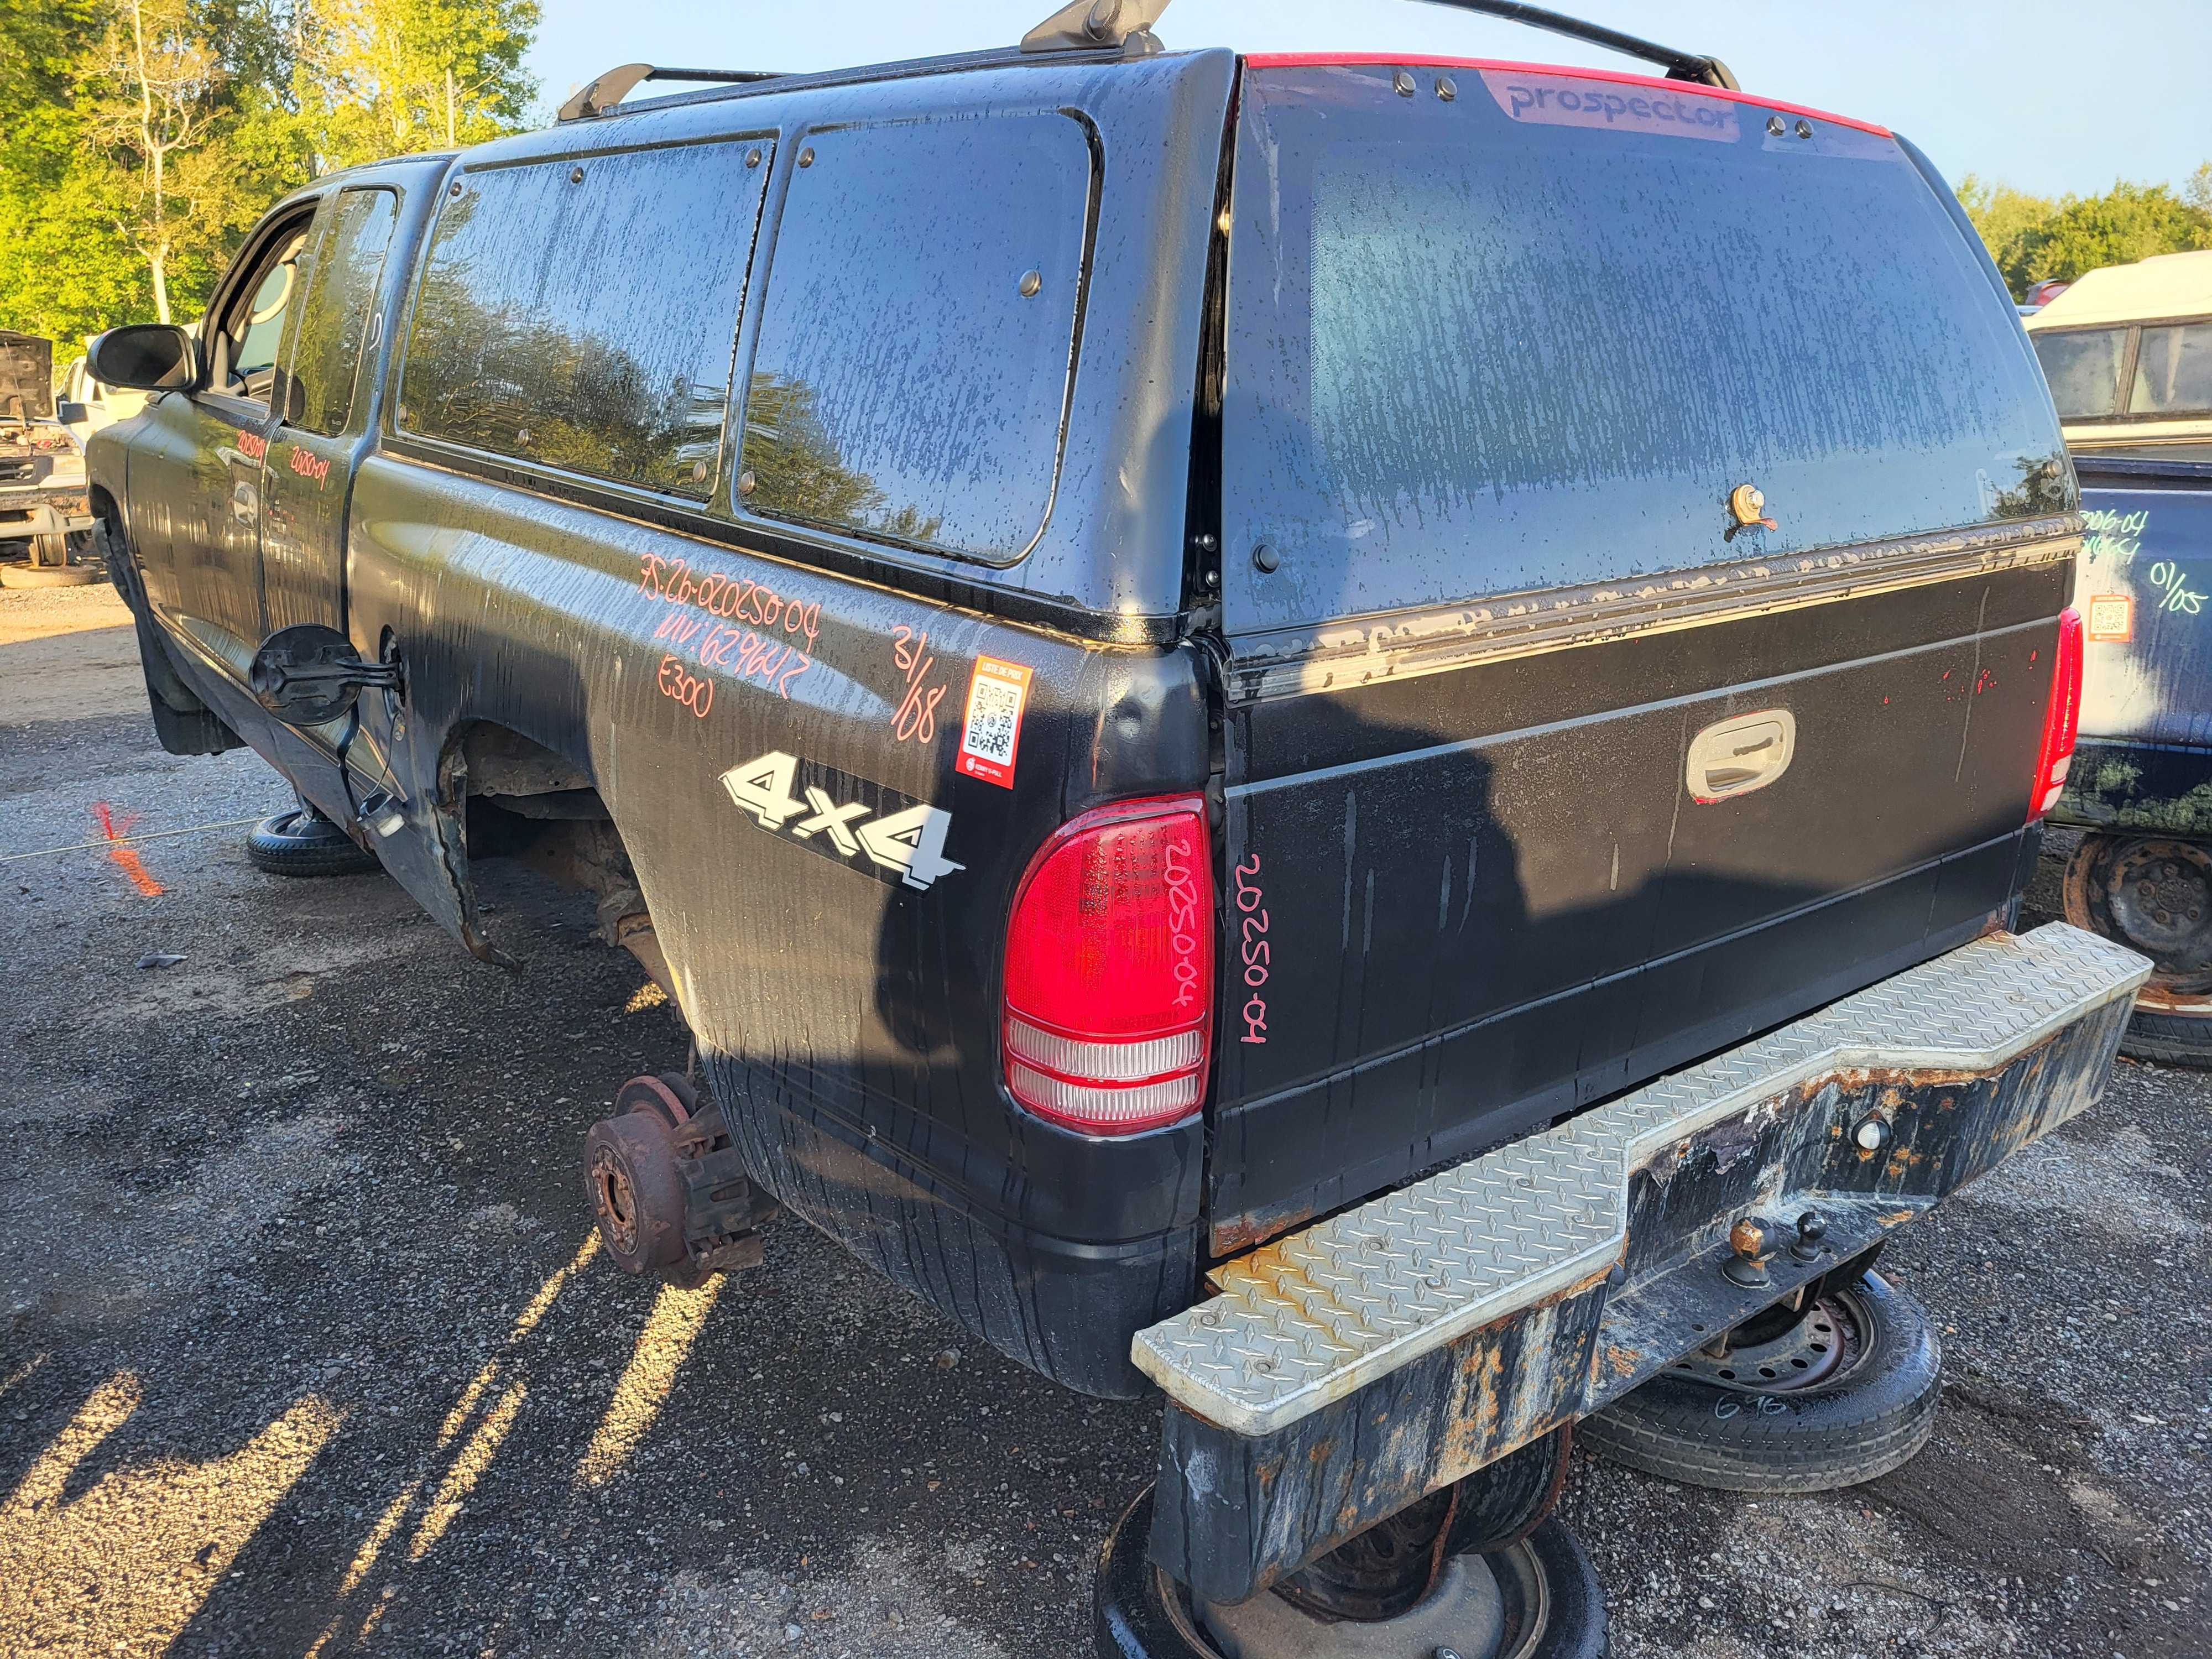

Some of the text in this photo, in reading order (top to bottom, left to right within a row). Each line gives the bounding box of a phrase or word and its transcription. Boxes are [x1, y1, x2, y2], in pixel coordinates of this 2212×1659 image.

[1507, 85, 1734, 129] prospector
[982, 662, 1023, 681] LISTE DE PRIX
